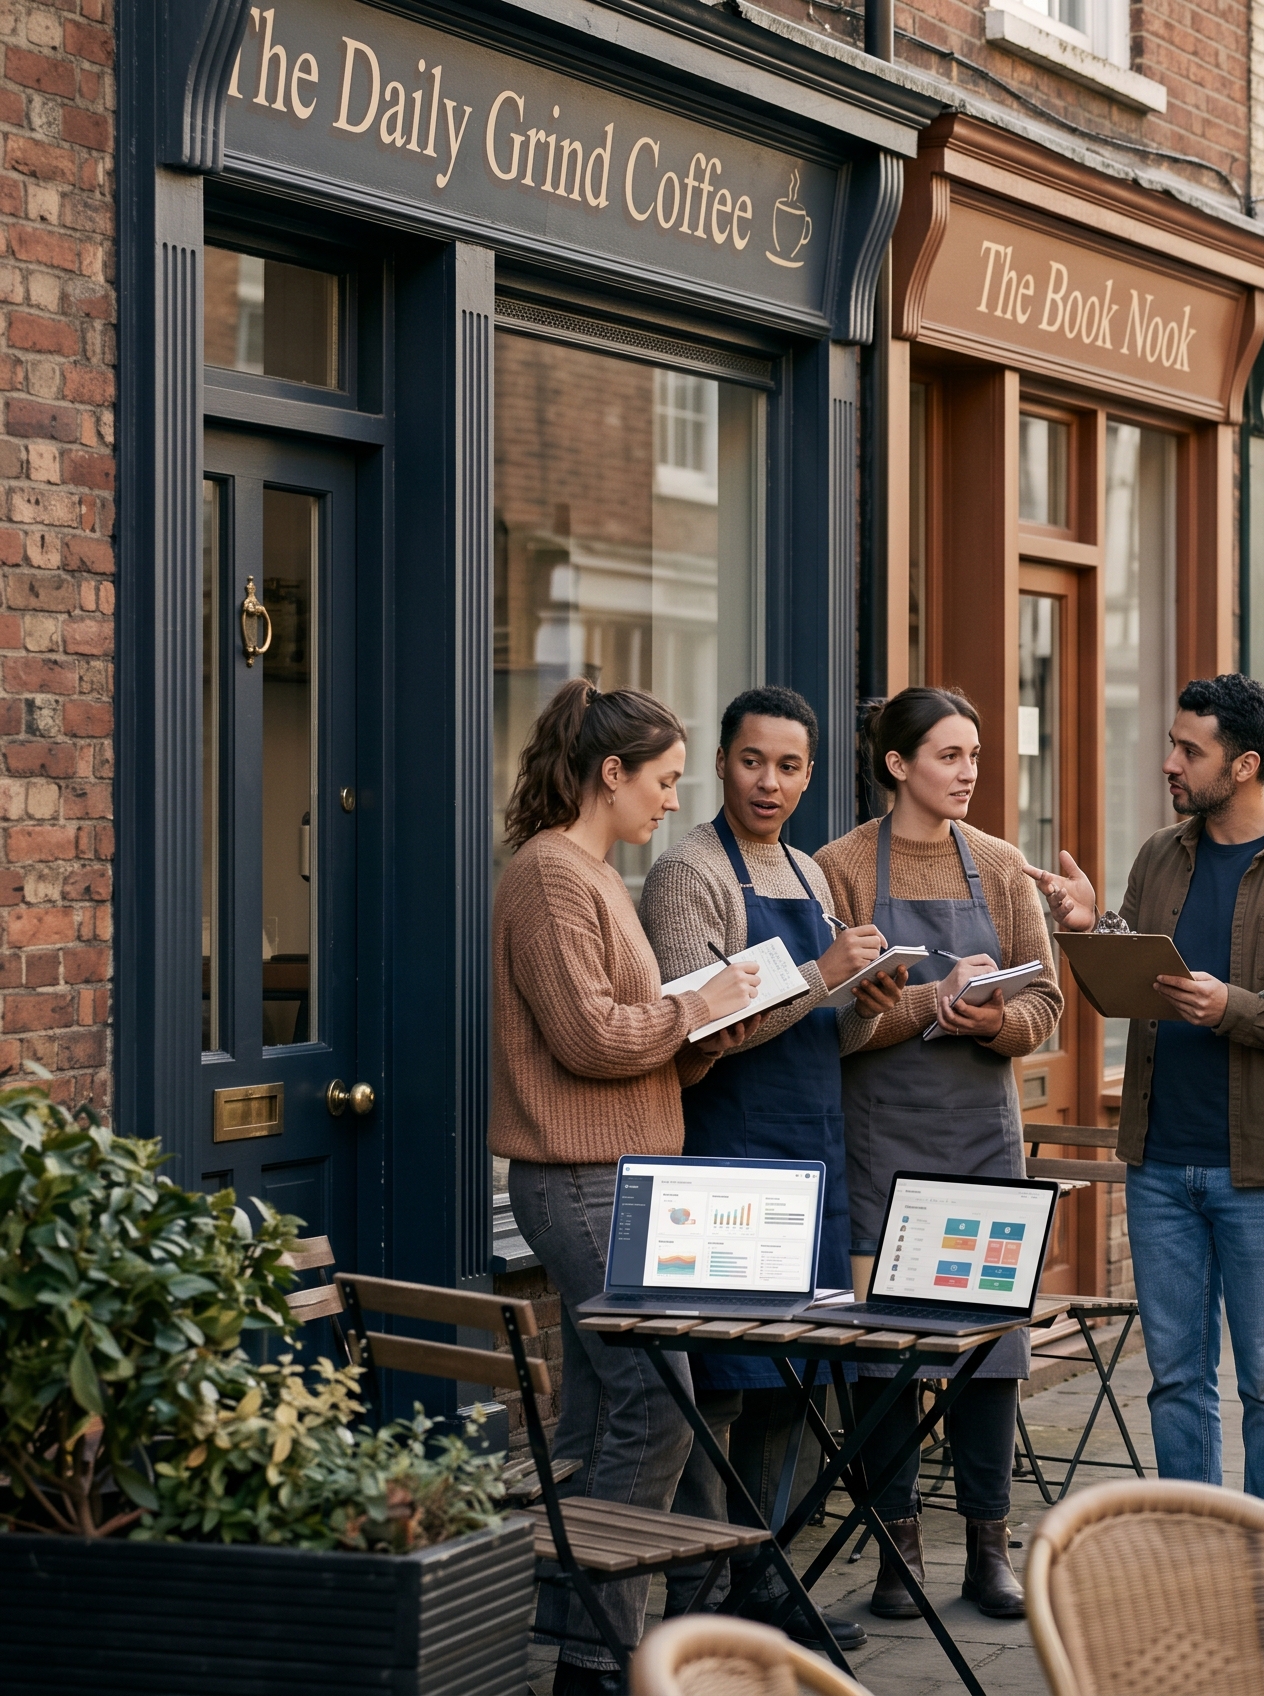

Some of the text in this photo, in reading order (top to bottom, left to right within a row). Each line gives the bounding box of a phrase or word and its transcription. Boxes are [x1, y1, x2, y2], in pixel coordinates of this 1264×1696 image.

[333, 36, 474, 188] Daily
[486, 90, 615, 209] Grind
[625, 137, 753, 251] Coffee
[976, 240, 1197, 373] The Book Nook
